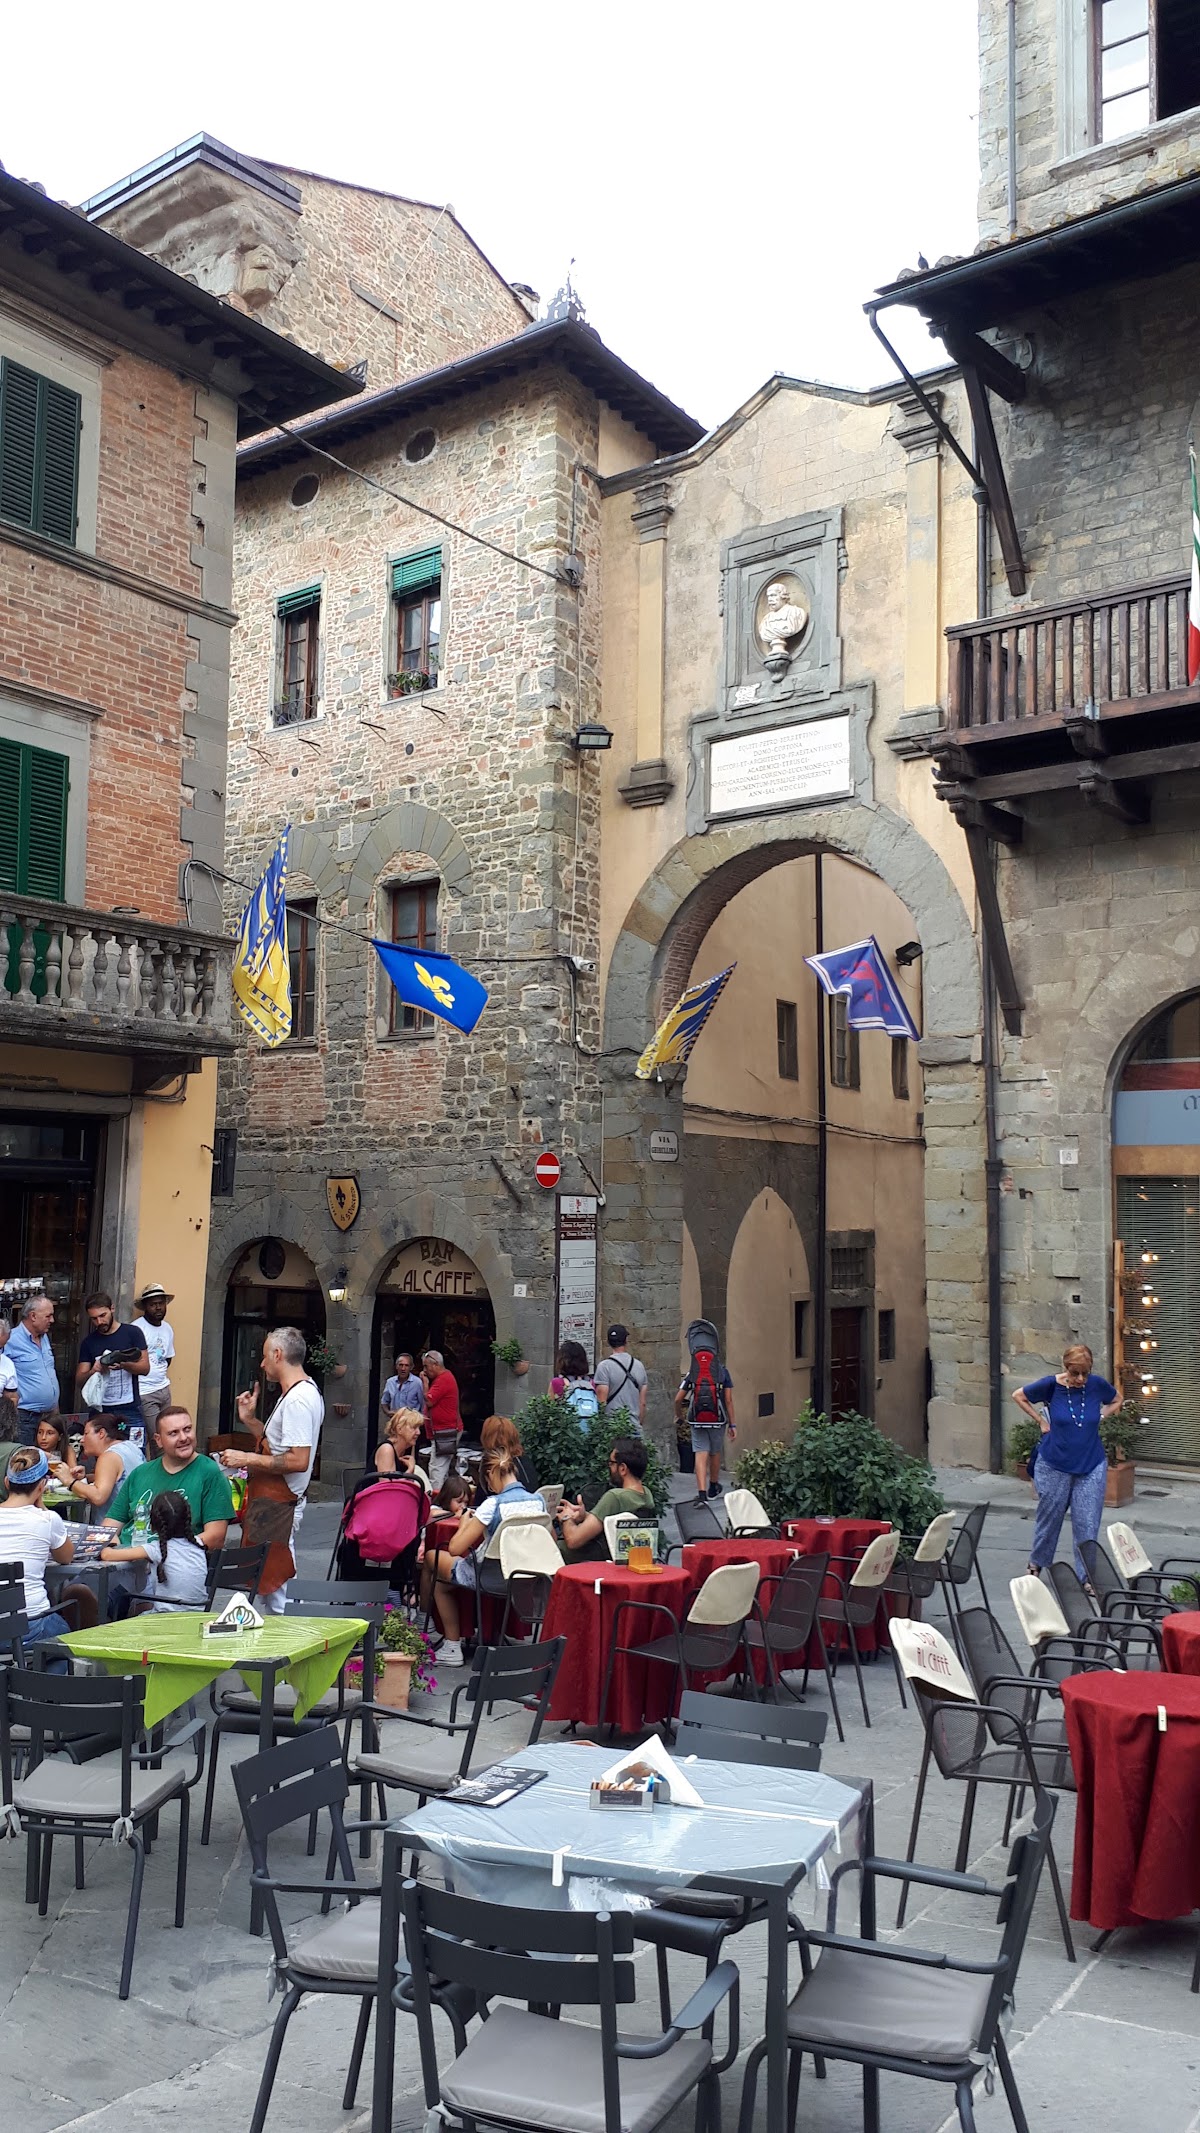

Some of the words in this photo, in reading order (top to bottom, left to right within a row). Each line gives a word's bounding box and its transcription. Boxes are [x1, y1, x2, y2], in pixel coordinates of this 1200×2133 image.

[658, 1136, 670, 1144] VIA
[420, 1240, 454, 1262] BAR
[403, 1269, 422, 1292] AL
[572, 1290, 594, 1298] PRELUDIO
